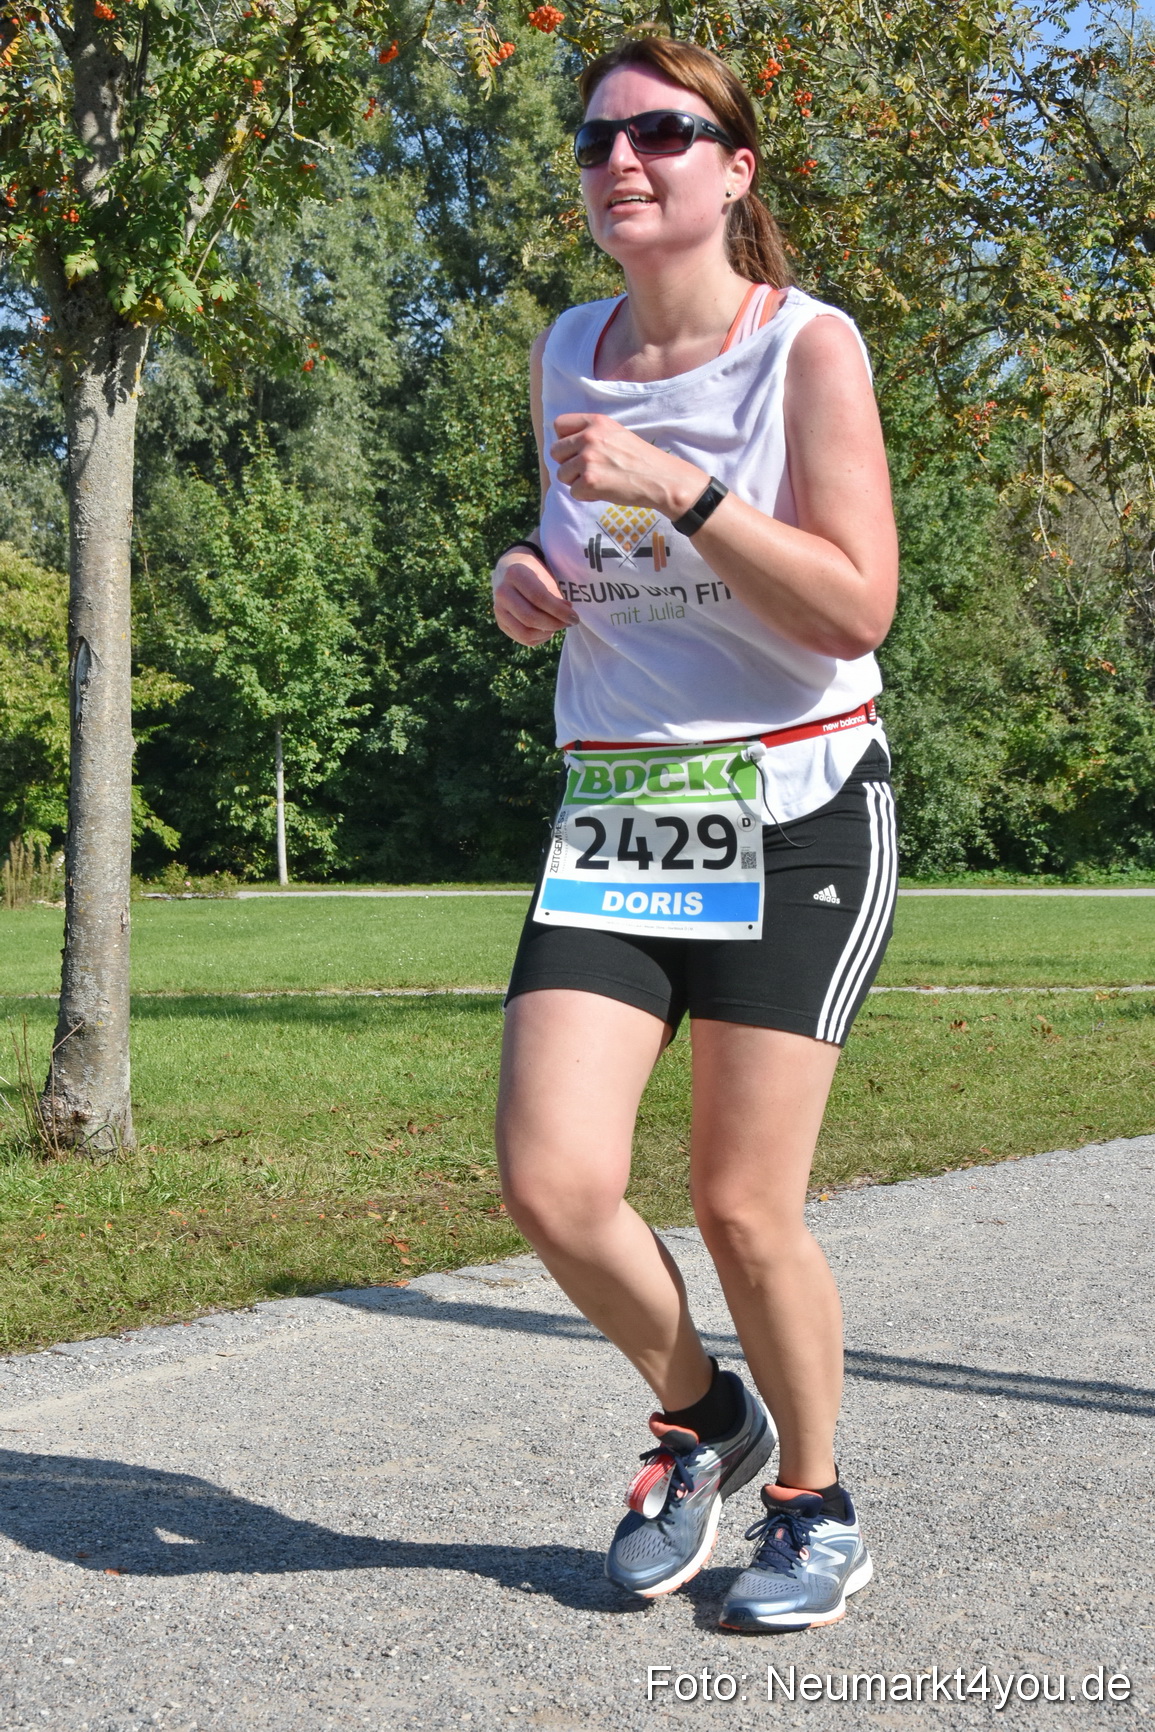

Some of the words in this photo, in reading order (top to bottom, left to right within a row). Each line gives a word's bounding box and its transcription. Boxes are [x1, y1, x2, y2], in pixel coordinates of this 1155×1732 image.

[695, 581, 732, 605] FIT
[610, 606, 641, 626] mit
[648, 602, 686, 622] Julia
[822, 721, 839, 732] new
[839, 714, 866, 728] balance
[576, 756, 733, 795] BOCK
[741, 817, 752, 828] D
[574, 814, 738, 870] 2429
[601, 890, 704, 916] DORIS
[813, 893, 841, 905] adidas
